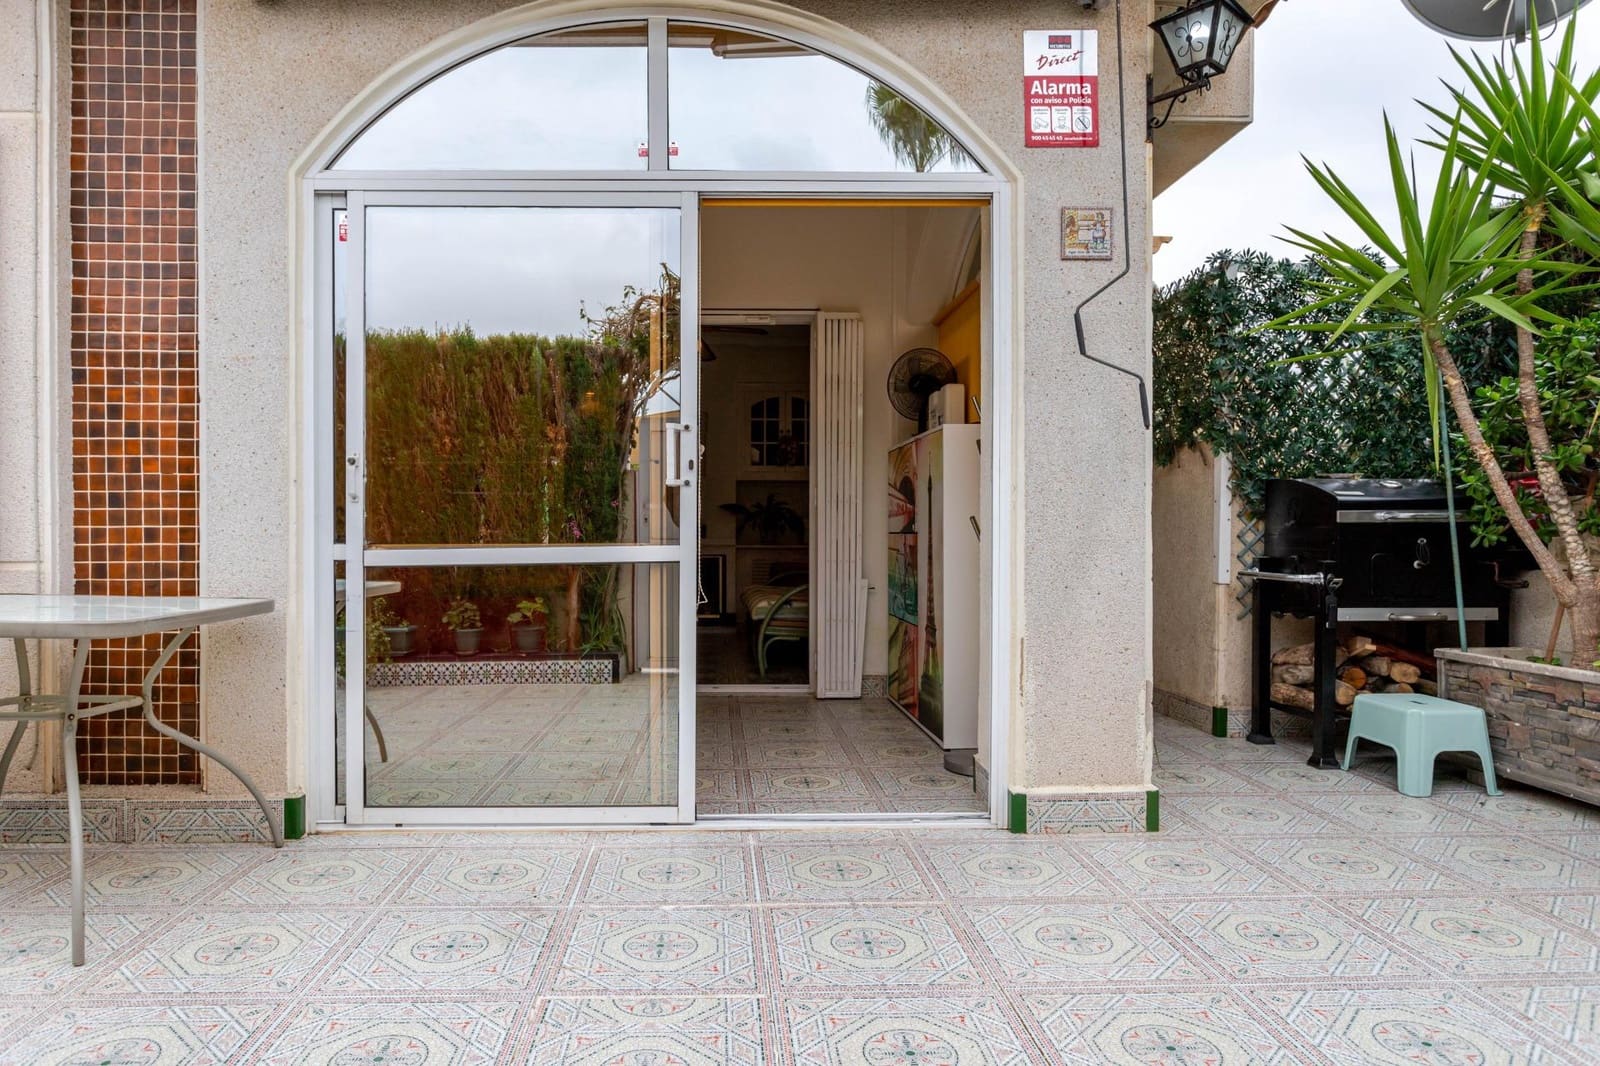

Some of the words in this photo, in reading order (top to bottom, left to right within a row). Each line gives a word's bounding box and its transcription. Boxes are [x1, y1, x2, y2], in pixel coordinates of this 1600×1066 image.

[1036, 50, 1084, 70] Direct
[1030, 79, 1092, 95] Alarma
[1044, 96, 1062, 104] aviso
[1069, 96, 1092, 104] Policía
